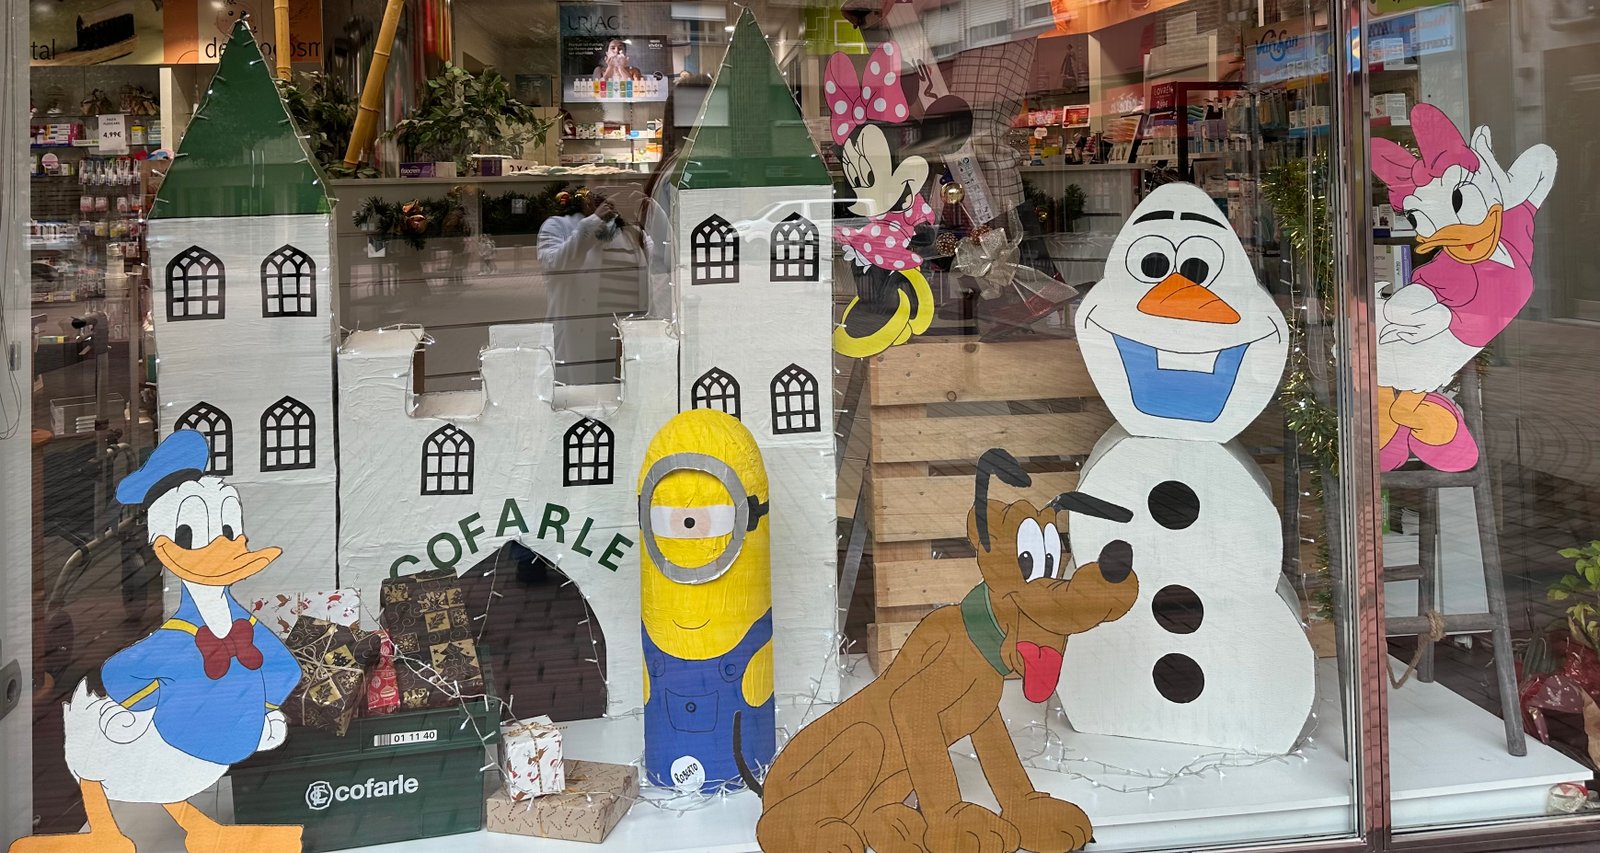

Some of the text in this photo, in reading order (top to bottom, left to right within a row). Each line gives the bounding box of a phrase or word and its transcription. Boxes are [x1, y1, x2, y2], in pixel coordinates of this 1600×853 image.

[389, 498, 634, 579] COFARLE
[394, 731, 435, 743] 01 11 40
[335, 774, 419, 801] cofarle
